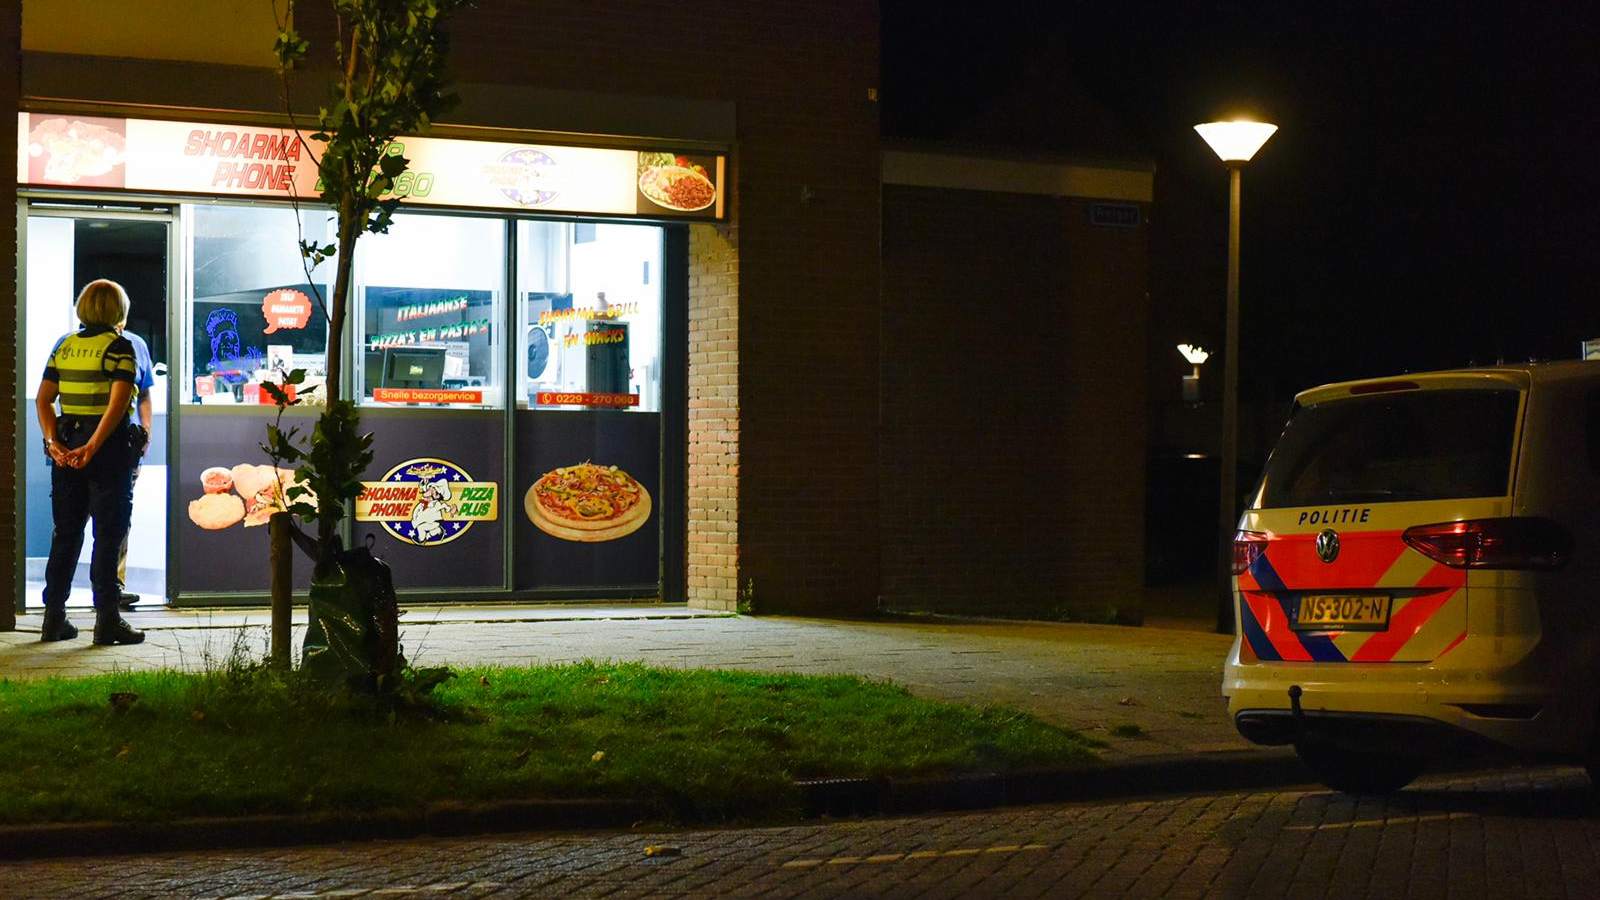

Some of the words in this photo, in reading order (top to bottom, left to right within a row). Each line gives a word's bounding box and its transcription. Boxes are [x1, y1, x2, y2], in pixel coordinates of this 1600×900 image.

[184, 130, 301, 162] SHOARMA
[212, 161, 297, 191] PHONE
[397, 296, 469, 321] ITALIAANSE
[381, 390, 410, 401] Snelle
[412, 391, 476, 403] bezorgservice
[556, 394, 583, 405] 0229
[592, 395, 613, 405] 270
[460, 487, 495, 502] PIZZA
[368, 502, 414, 517] PHONE
[458, 501, 491, 517] PLUS
[1299, 508, 1371, 526] POLITIE
[1303, 598, 1383, 620] NS-302-N
